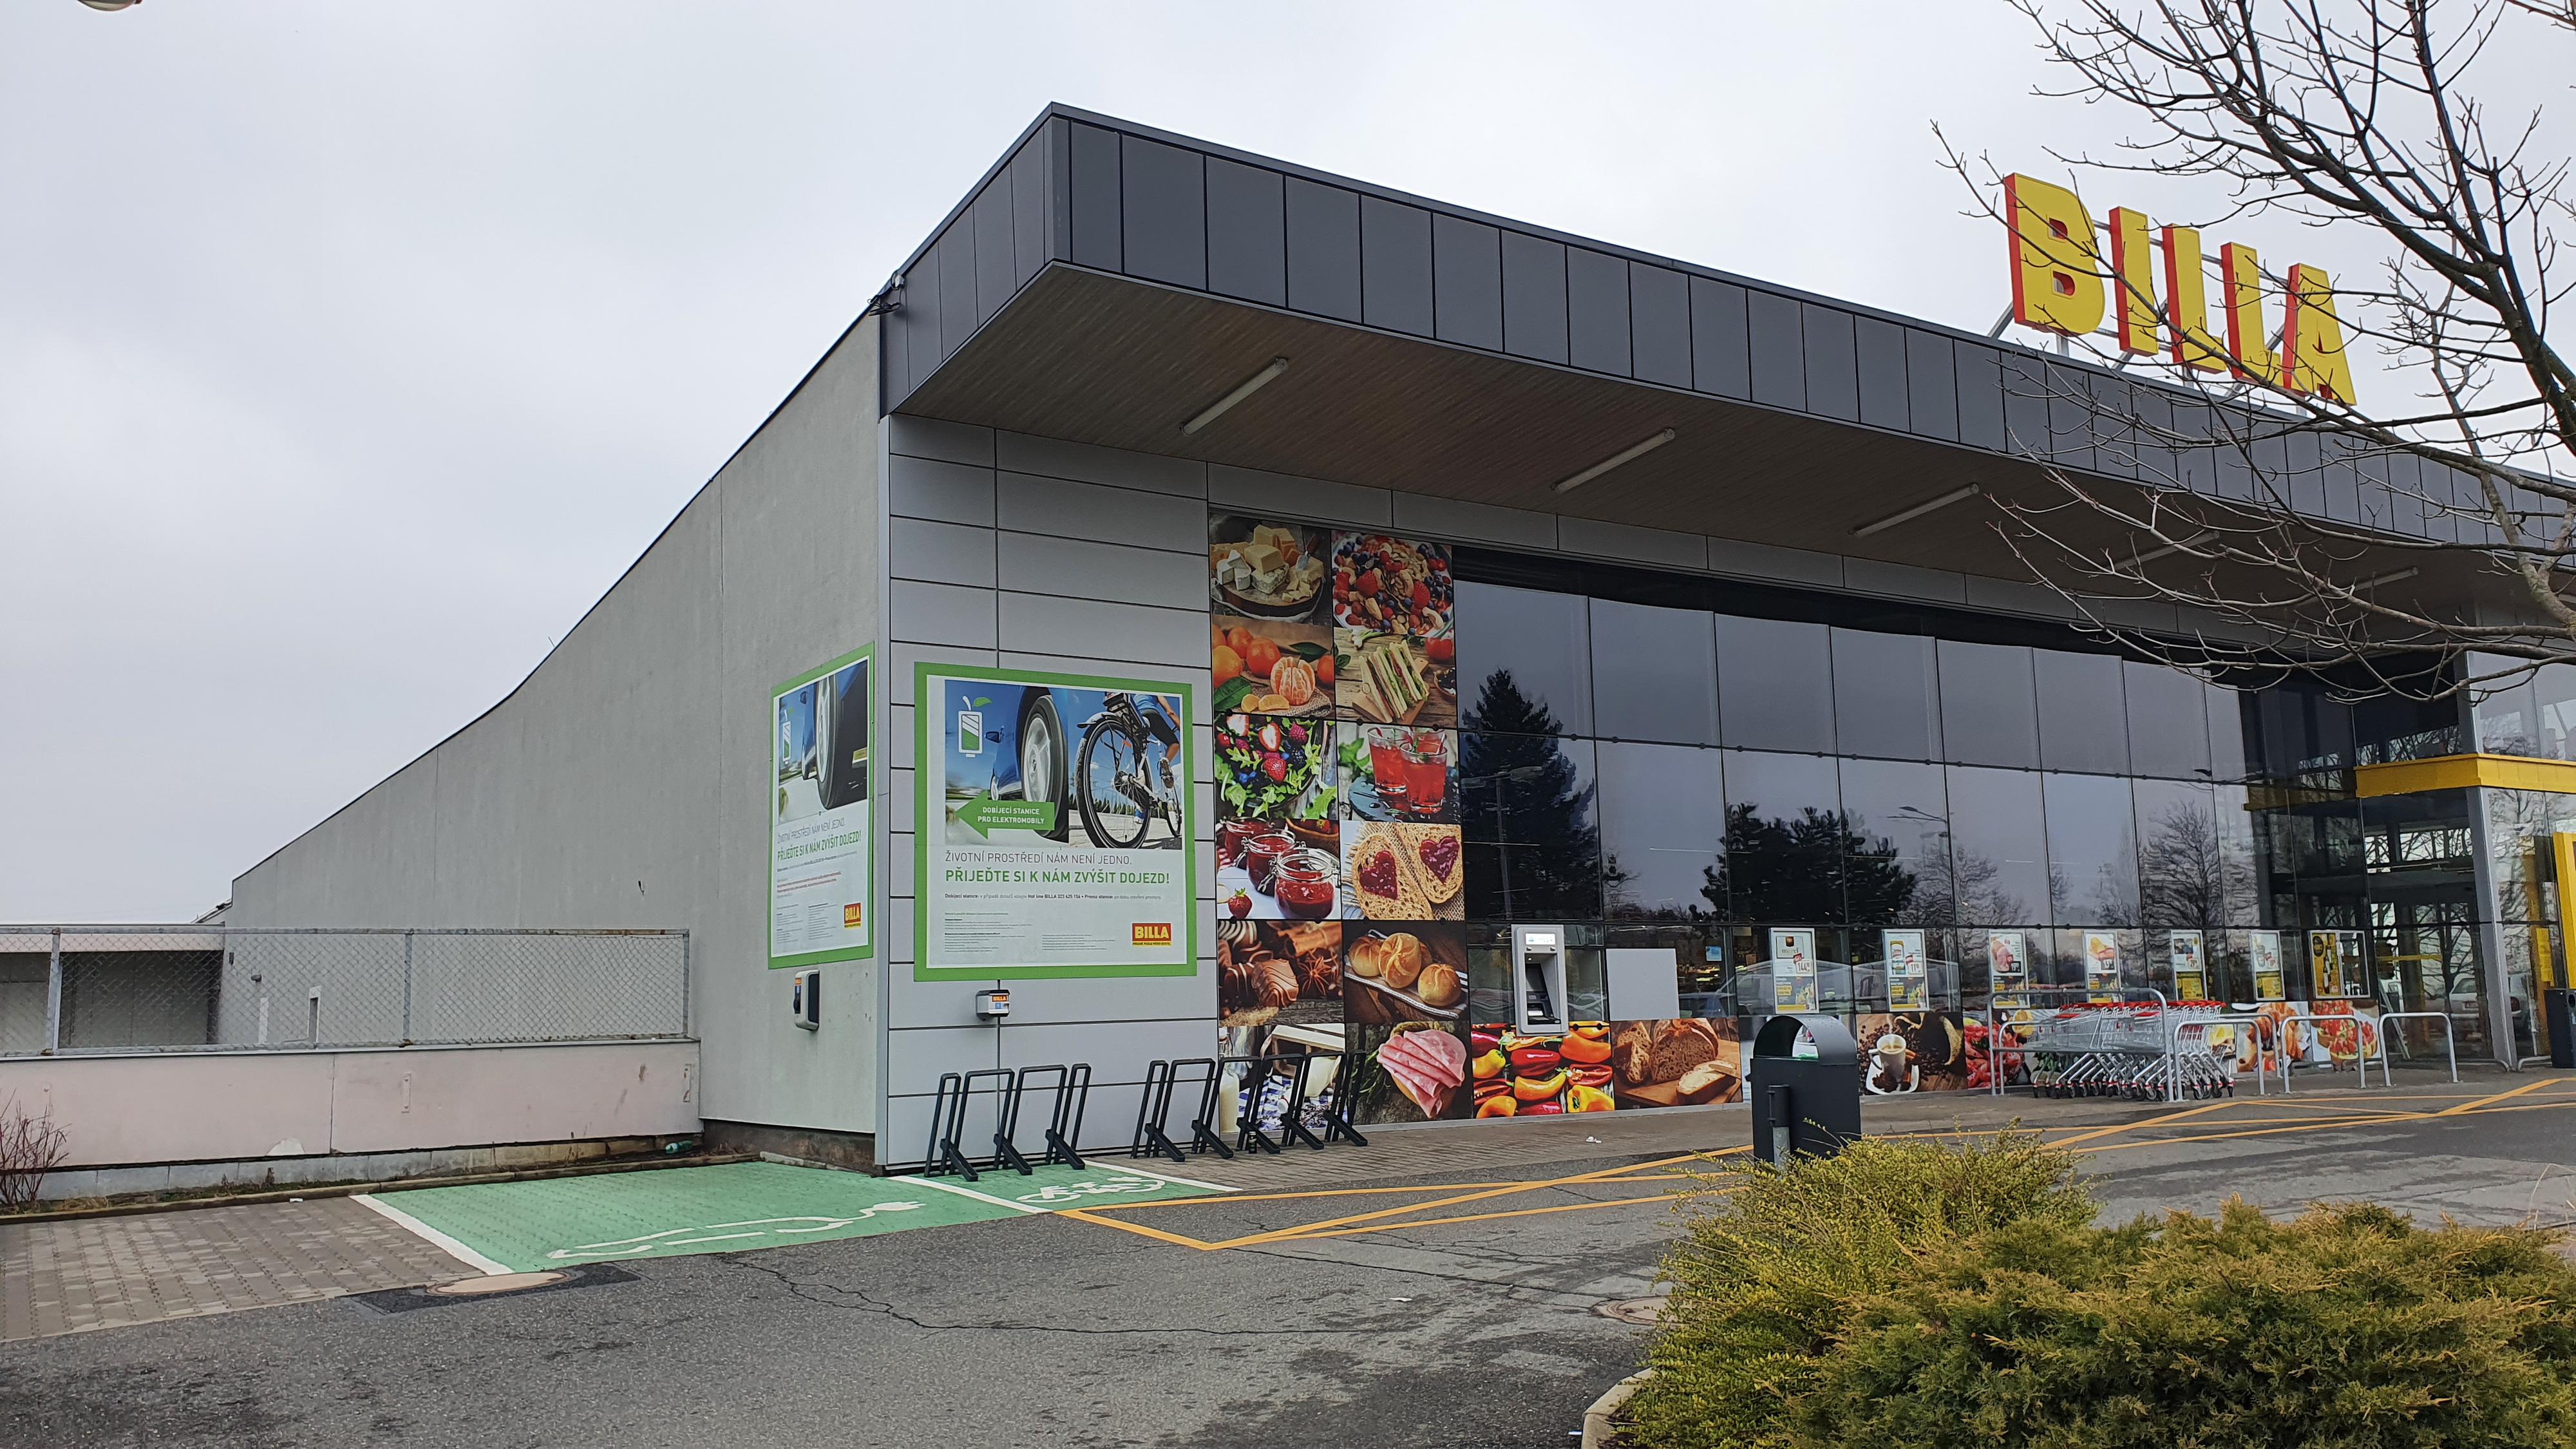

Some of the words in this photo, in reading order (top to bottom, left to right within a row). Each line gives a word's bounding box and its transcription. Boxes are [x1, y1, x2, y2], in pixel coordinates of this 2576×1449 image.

[2003, 173, 2357, 406] BILLA
[983, 806, 1012, 814] DOBÍJECÍ
[805, 844, 809, 854] K
[810, 838, 820, 853] NÁM
[822, 834, 838, 850] ZVÝŠIT
[839, 830, 861, 846] DOJEZD!
[945, 850, 985, 862] ŽIVOTNÍ
[988, 851, 1043, 863] PROSTŘEDÍ
[1046, 852, 1068, 864] NÁM
[1072, 853, 1095, 864] NENÍ
[1098, 855, 1132, 865] JEDNO.
[946, 866, 1010, 882] PŘIJEĎTE
[1014, 871, 1025, 882] SI
[1030, 871, 1038, 882] K
[1042, 868, 1070, 883] NÁM
[1074, 869, 1116, 884] ZVÝŠIT
[1120, 873, 1170, 884] DOJEZD!
[845, 906, 860, 921] BILLA
[1135, 926, 1170, 938] BILLA
